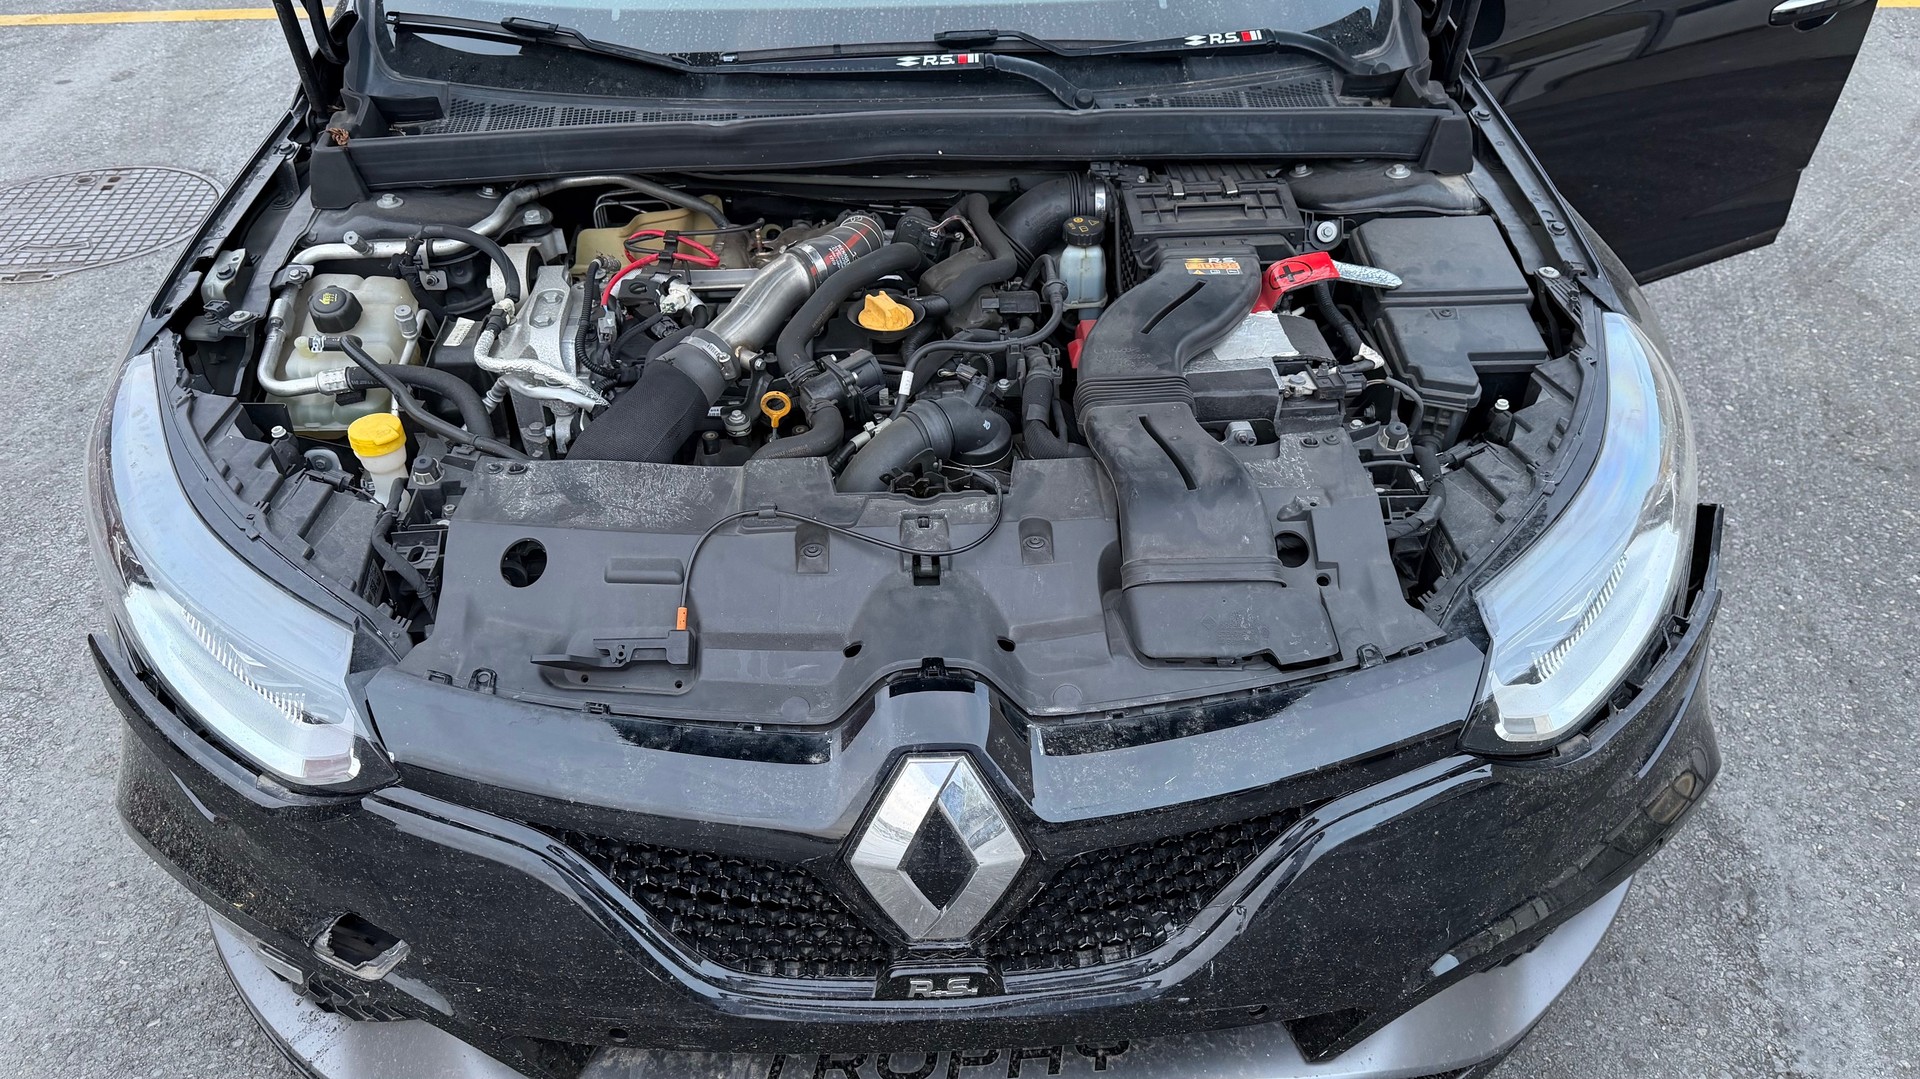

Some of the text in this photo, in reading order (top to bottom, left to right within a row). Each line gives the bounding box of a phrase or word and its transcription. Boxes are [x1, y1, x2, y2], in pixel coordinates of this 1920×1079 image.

[1209, 32, 1240, 44] R.S.
[923, 54, 955, 66] R.S.
[908, 976, 978, 998] R.S.
